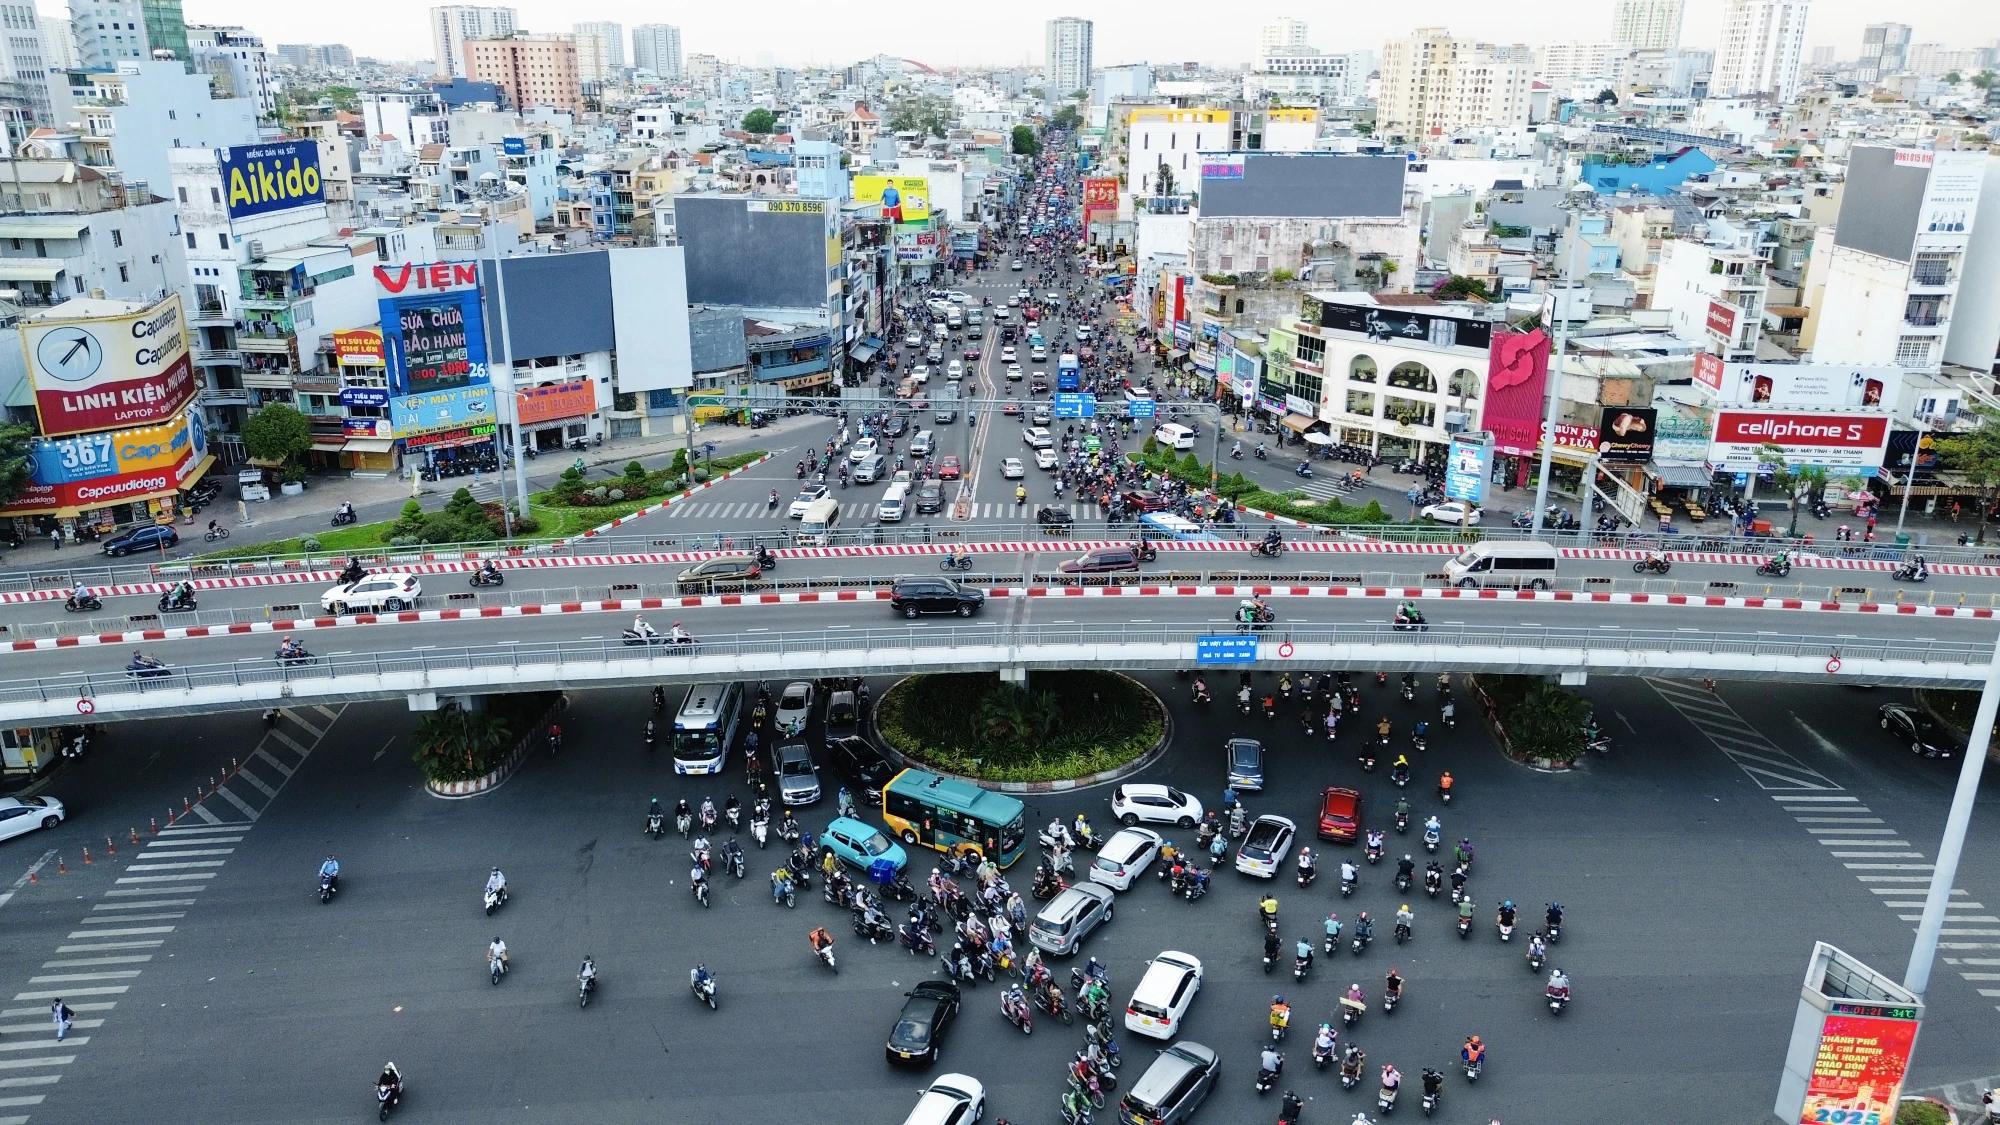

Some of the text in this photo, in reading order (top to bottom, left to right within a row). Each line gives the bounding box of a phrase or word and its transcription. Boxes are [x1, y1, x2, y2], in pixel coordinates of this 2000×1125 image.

[229, 157, 319, 207] Aikido
[768, 201, 823, 212] 090 370 8596
[372, 261, 475, 293] VIỆN
[400, 306, 463, 331] SỬA CHỮA
[403, 329, 466, 353] BẢO HÀNH
[341, 345, 378, 354] CHỢ LỚN
[62, 391, 117, 412] LINH
[121, 382, 166, 406] KIỆN
[114, 407, 153, 420] LAPTOP
[1555, 423, 1579, 435] BÚN
[1582, 426, 1598, 438] BÒ
[1737, 419, 1863, 440] cellphone S
[407, 432, 442, 448] KHÔNG
[1559, 436, 1567, 445] 9
[1569, 435, 1595, 449] LỬA
[60, 439, 112, 469] 367
[77, 475, 166, 499] Capcuudidong
[1821, 1036, 1879, 1046] THÀNH PHỐ
[1836, 1045, 1854, 1053] CHÍ
[1855, 1046, 1884, 1055] MINH
[1815, 1061, 1866, 1070] CHÀO ĐÓN
[1841, 1054, 1869, 1062] HOAN
[1813, 1068, 1838, 1077] NĂM
[1815, 1108, 1880, 1125] 2025
